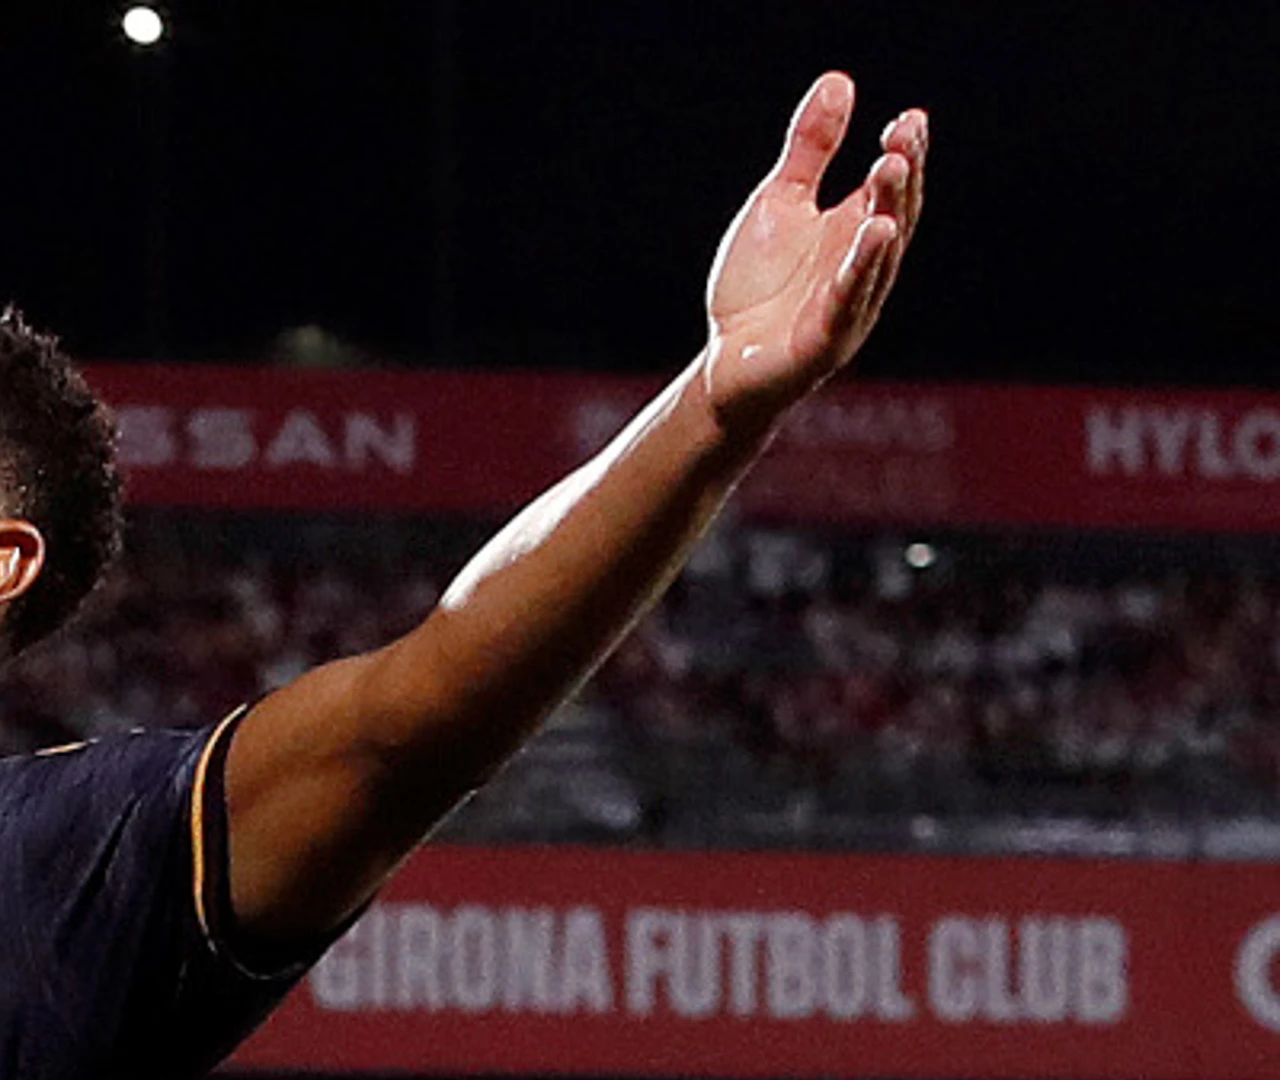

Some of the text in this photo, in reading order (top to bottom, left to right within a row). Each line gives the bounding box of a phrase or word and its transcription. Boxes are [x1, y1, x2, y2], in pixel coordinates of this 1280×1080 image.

[306, 903, 614, 1015] GIRONA
[626, 907, 915, 1019] FUTBOL
[926, 915, 1130, 1023] CLUB
